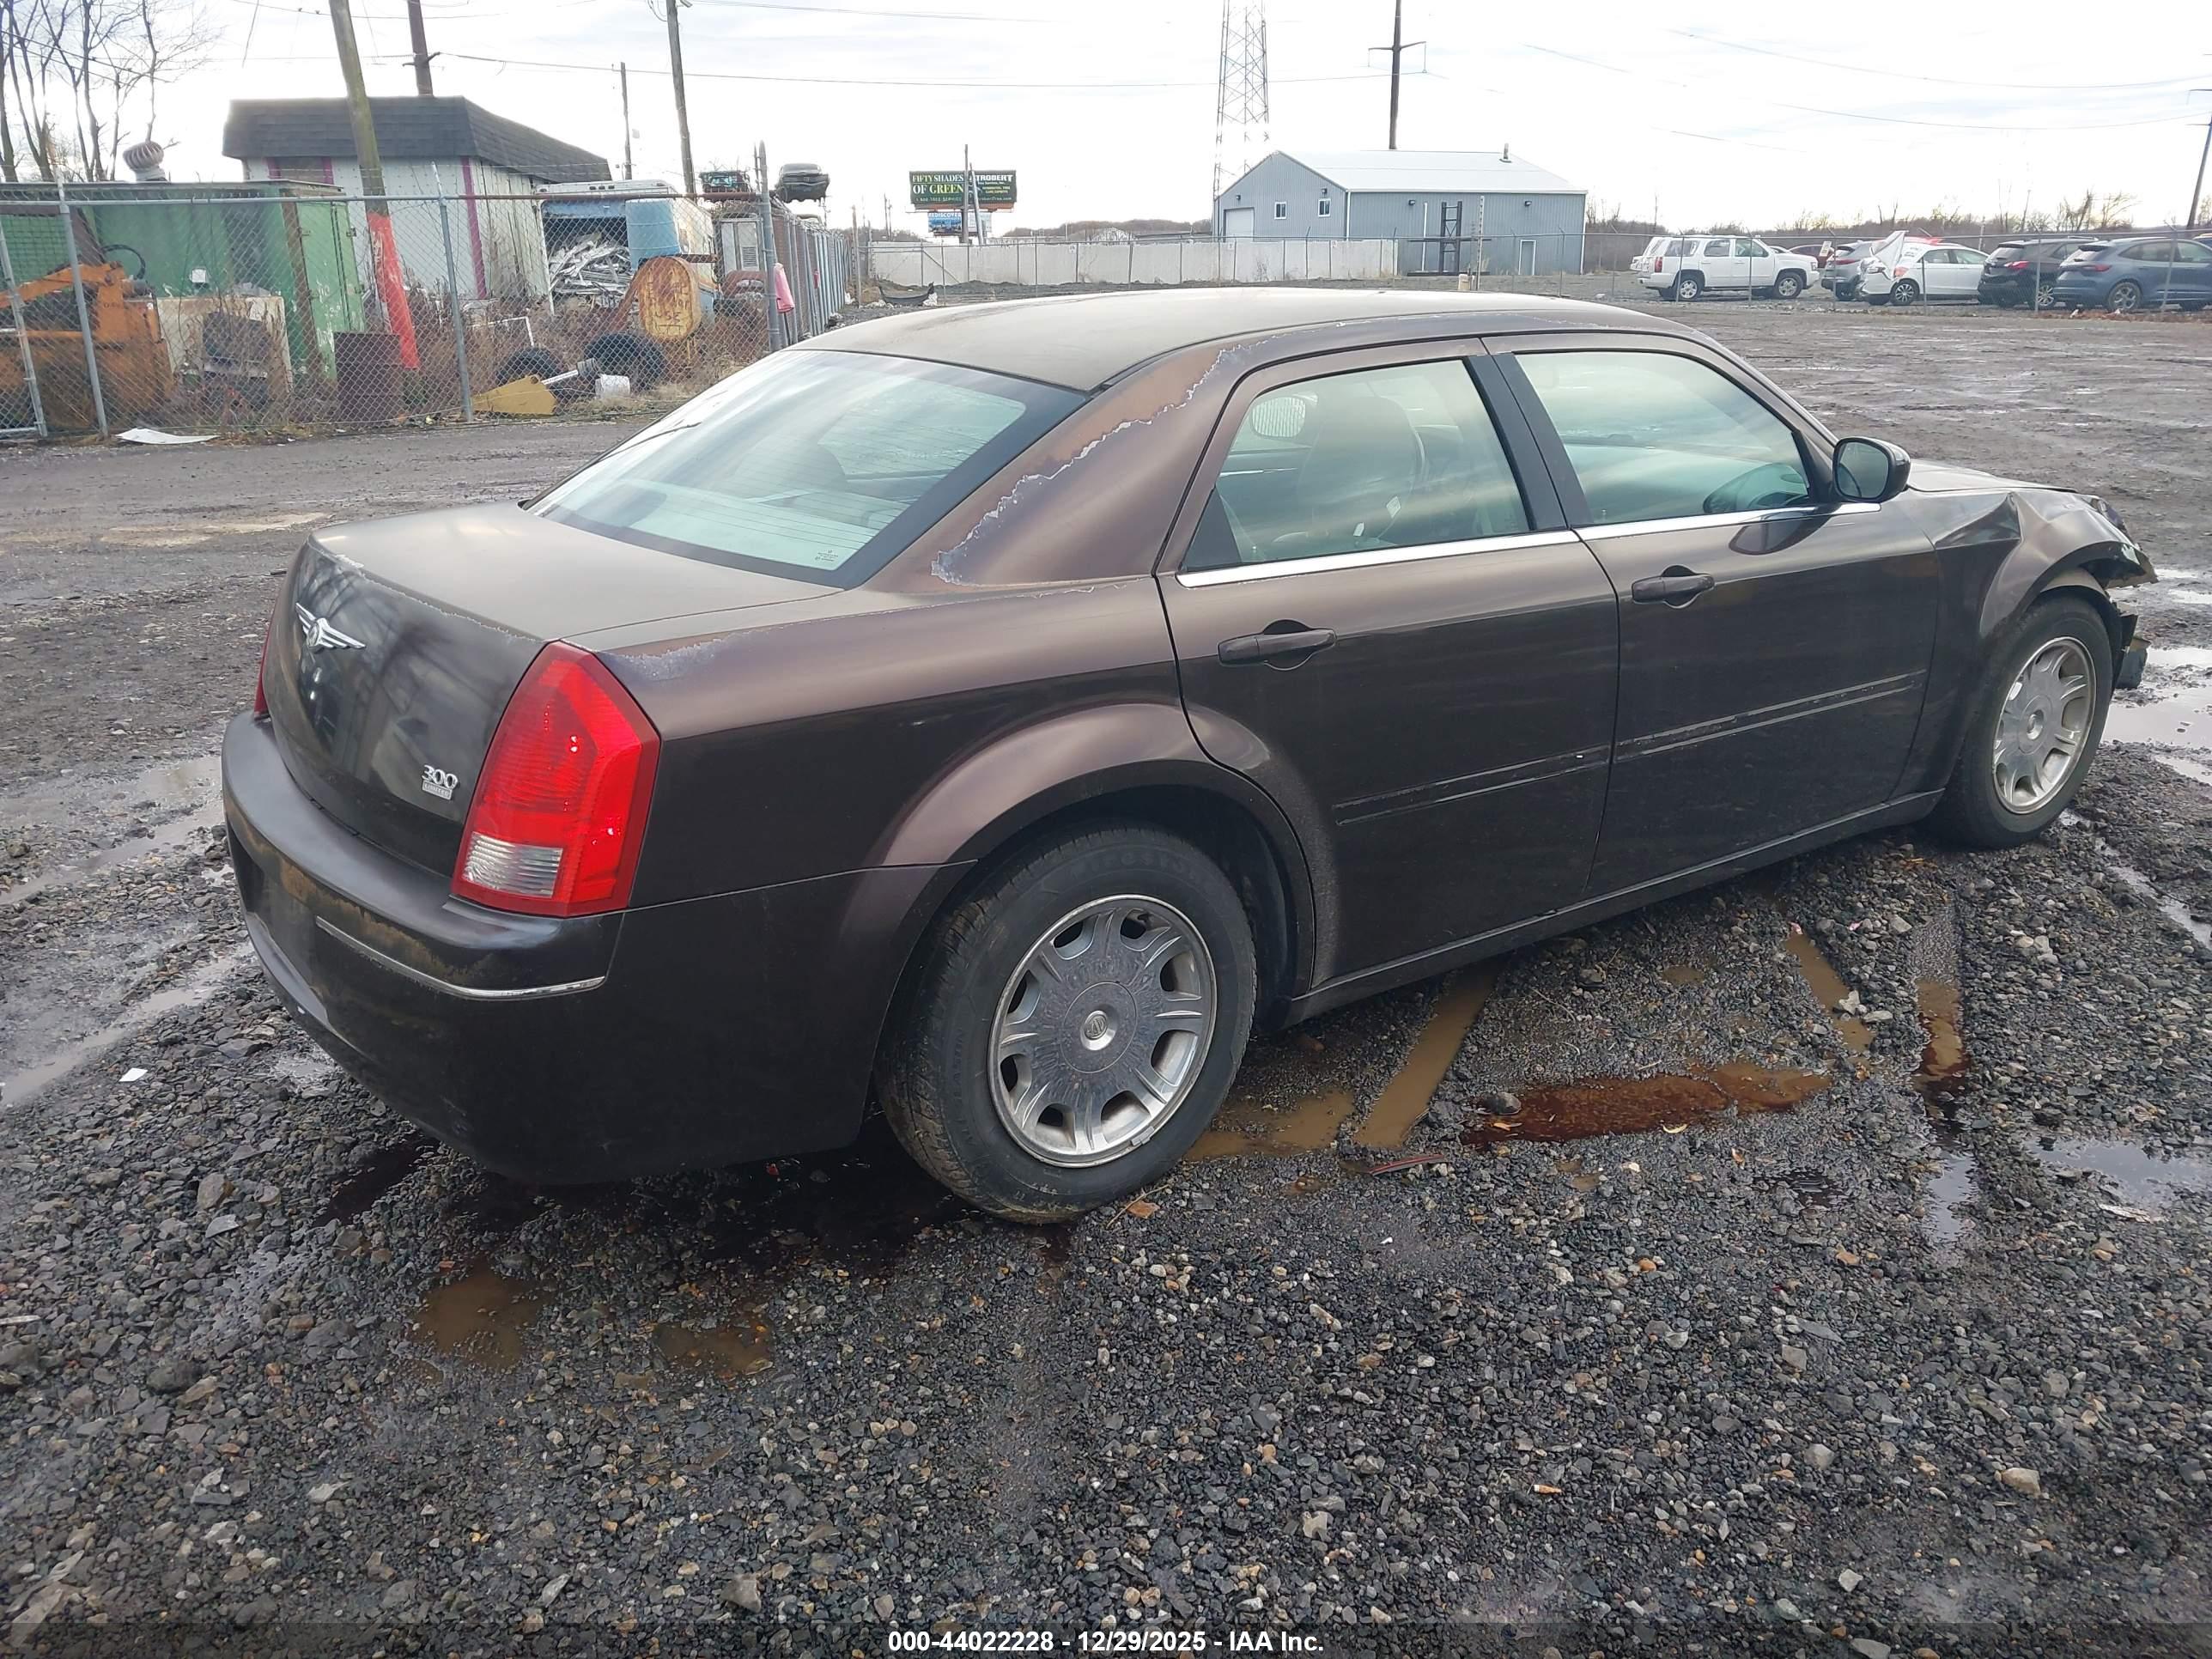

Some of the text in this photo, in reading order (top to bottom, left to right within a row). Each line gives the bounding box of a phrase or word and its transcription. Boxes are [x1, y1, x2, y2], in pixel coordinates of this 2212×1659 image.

[913, 184, 964, 194] OF GREEN
[422, 764, 459, 789] 300
